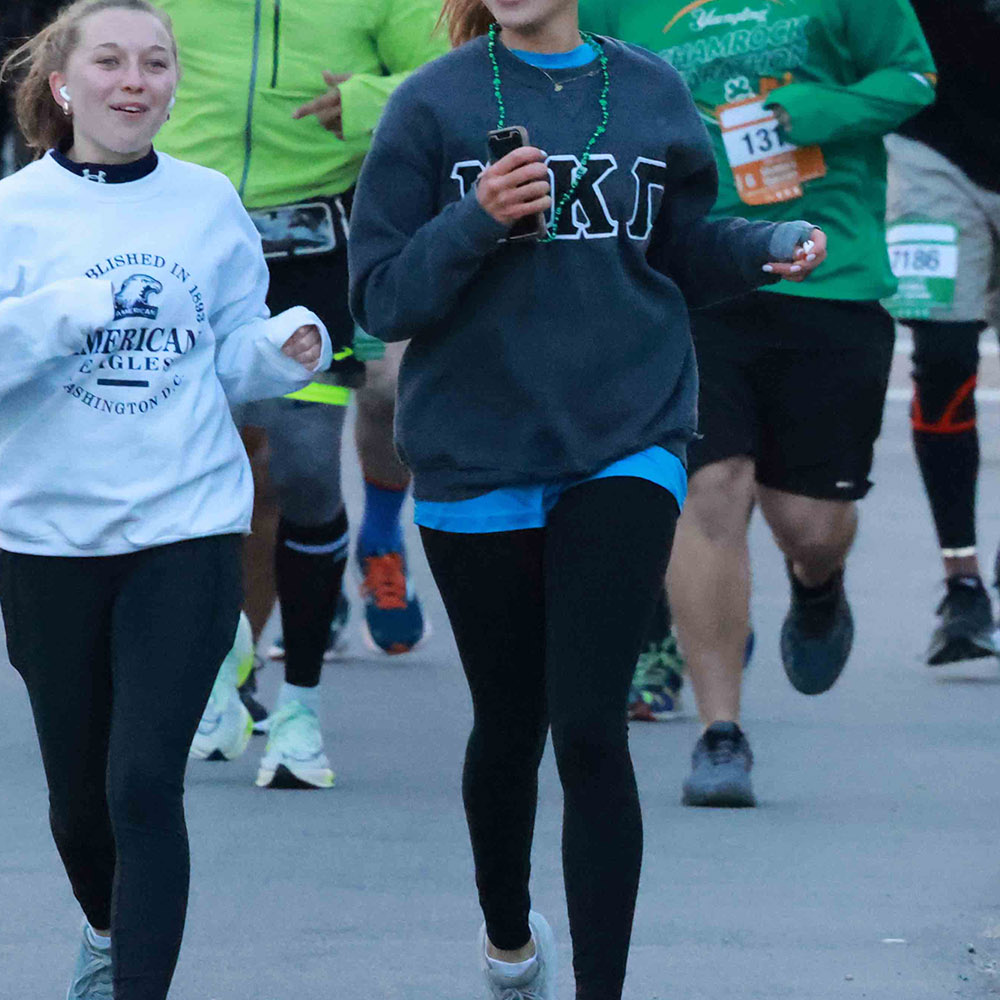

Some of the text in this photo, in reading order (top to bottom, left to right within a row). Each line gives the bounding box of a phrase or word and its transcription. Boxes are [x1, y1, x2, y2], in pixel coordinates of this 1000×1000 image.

[84, 252, 206, 324] BLISHED IN 1893
[74, 326, 198, 356] MERICAN
[79, 354, 176, 374] EGLES
[63, 380, 159, 416] ASHINGTON
